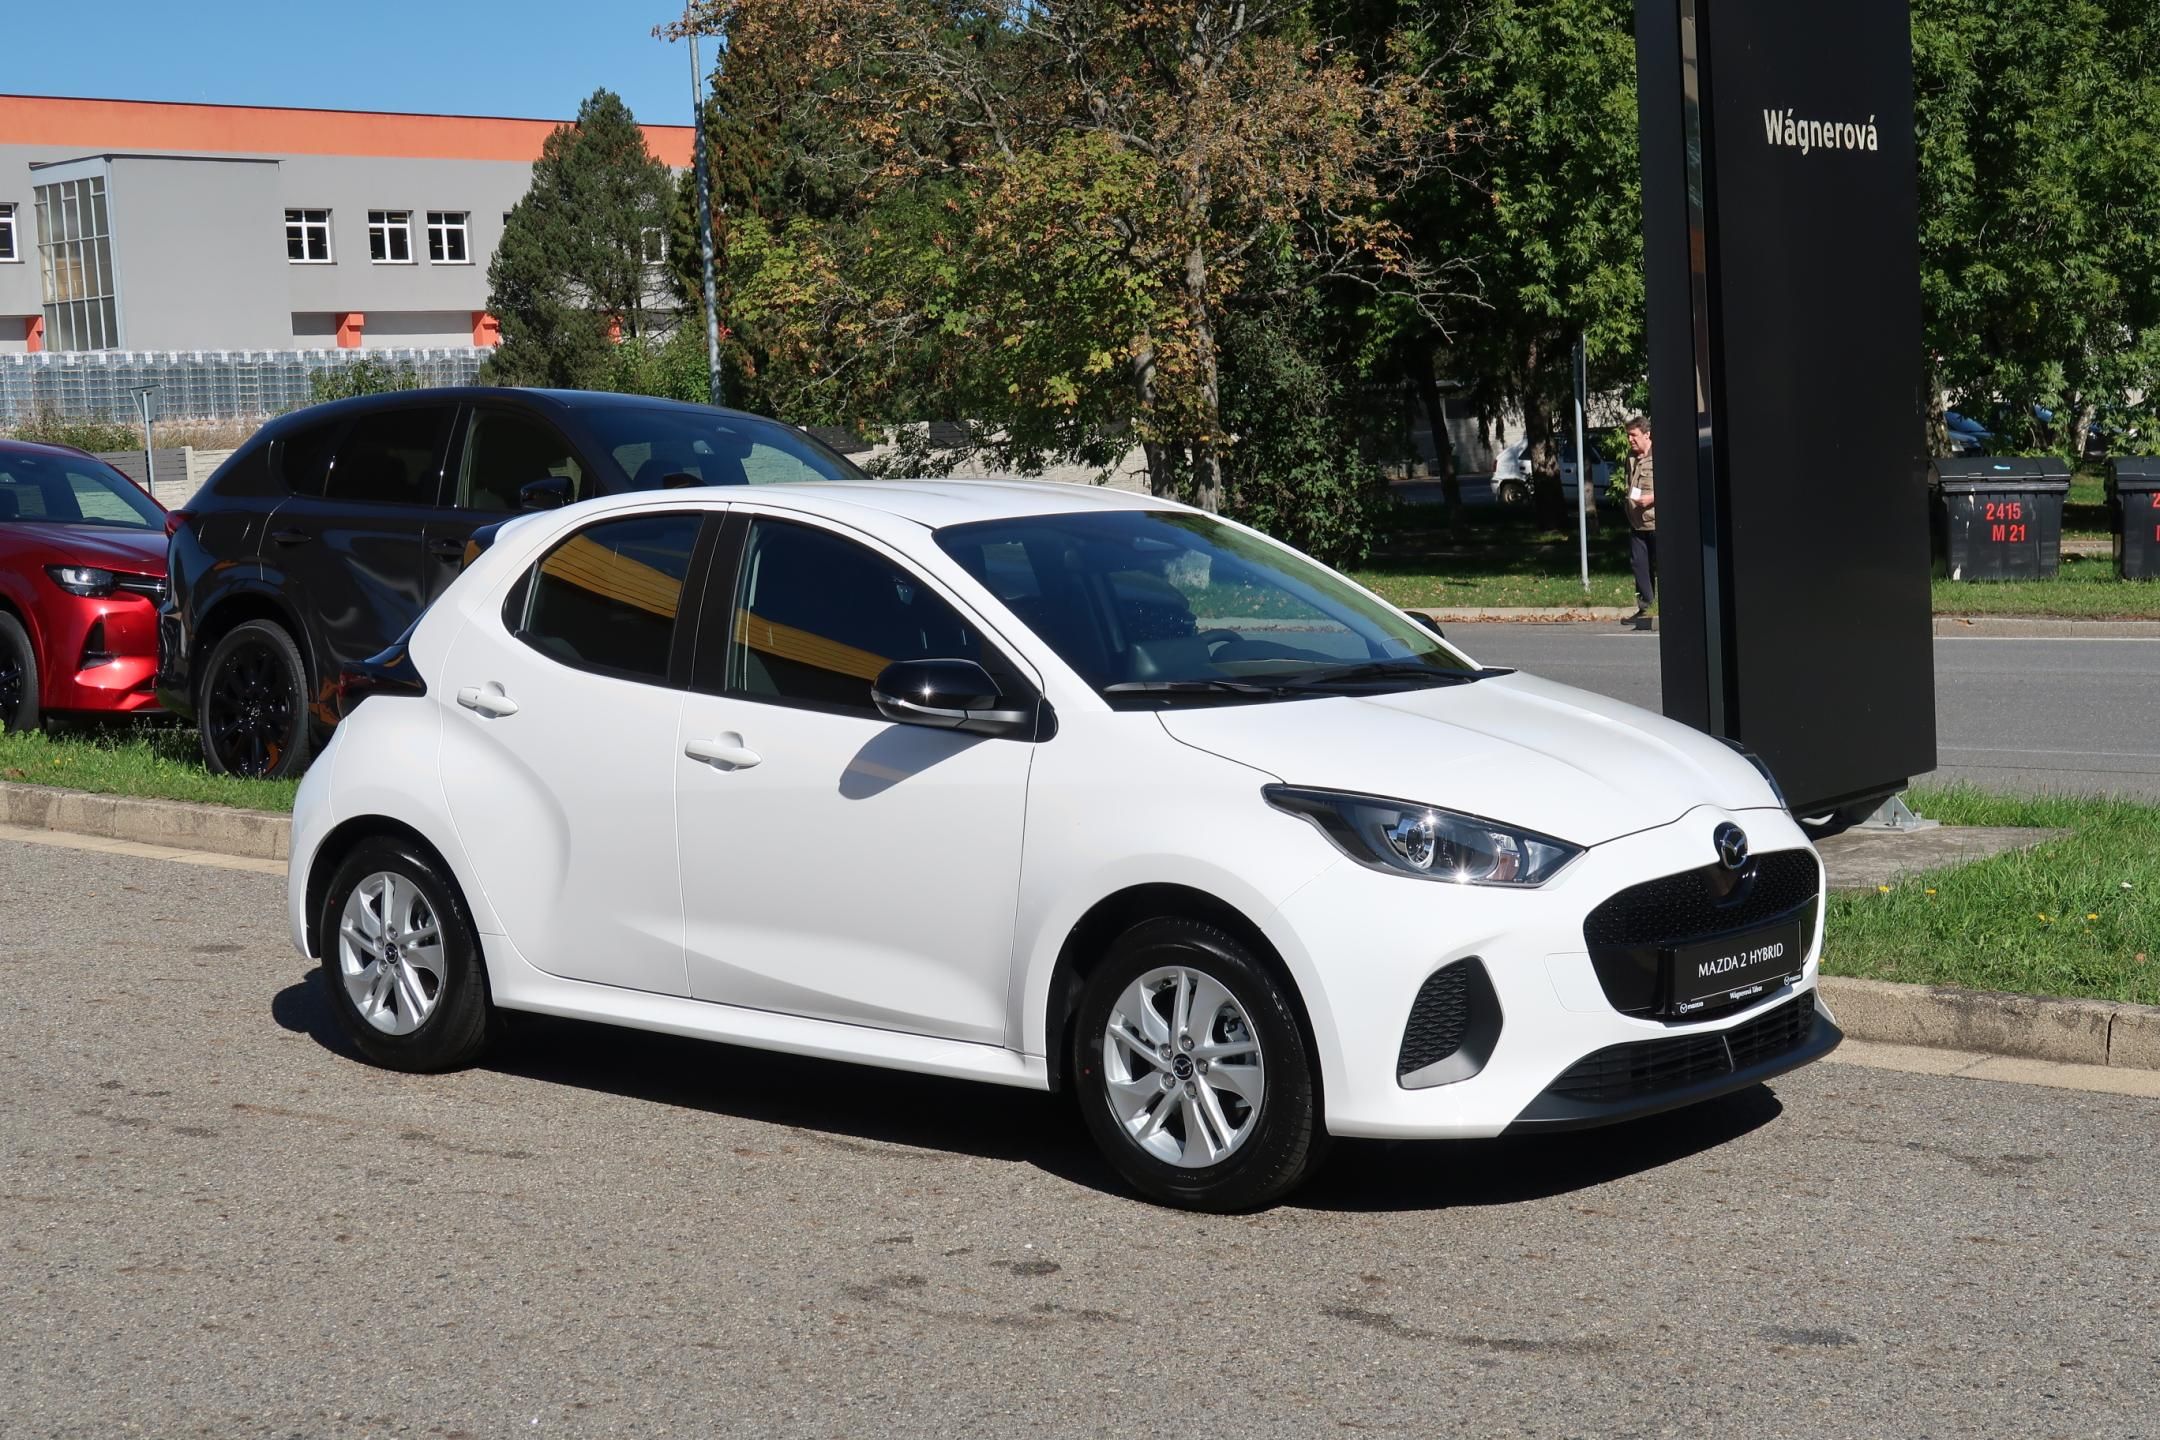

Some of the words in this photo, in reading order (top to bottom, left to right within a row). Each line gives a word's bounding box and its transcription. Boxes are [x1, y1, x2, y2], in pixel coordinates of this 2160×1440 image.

[1763, 108, 1878, 156] Wágnerová
[1985, 502, 2022, 521] 2415
[1992, 524, 2006, 541] M
[2009, 524, 2027, 542] 21
[1698, 955, 1739, 978] MAZDA
[1740, 952, 1747, 967] 2
[1749, 942, 1784, 965] HYBRID
